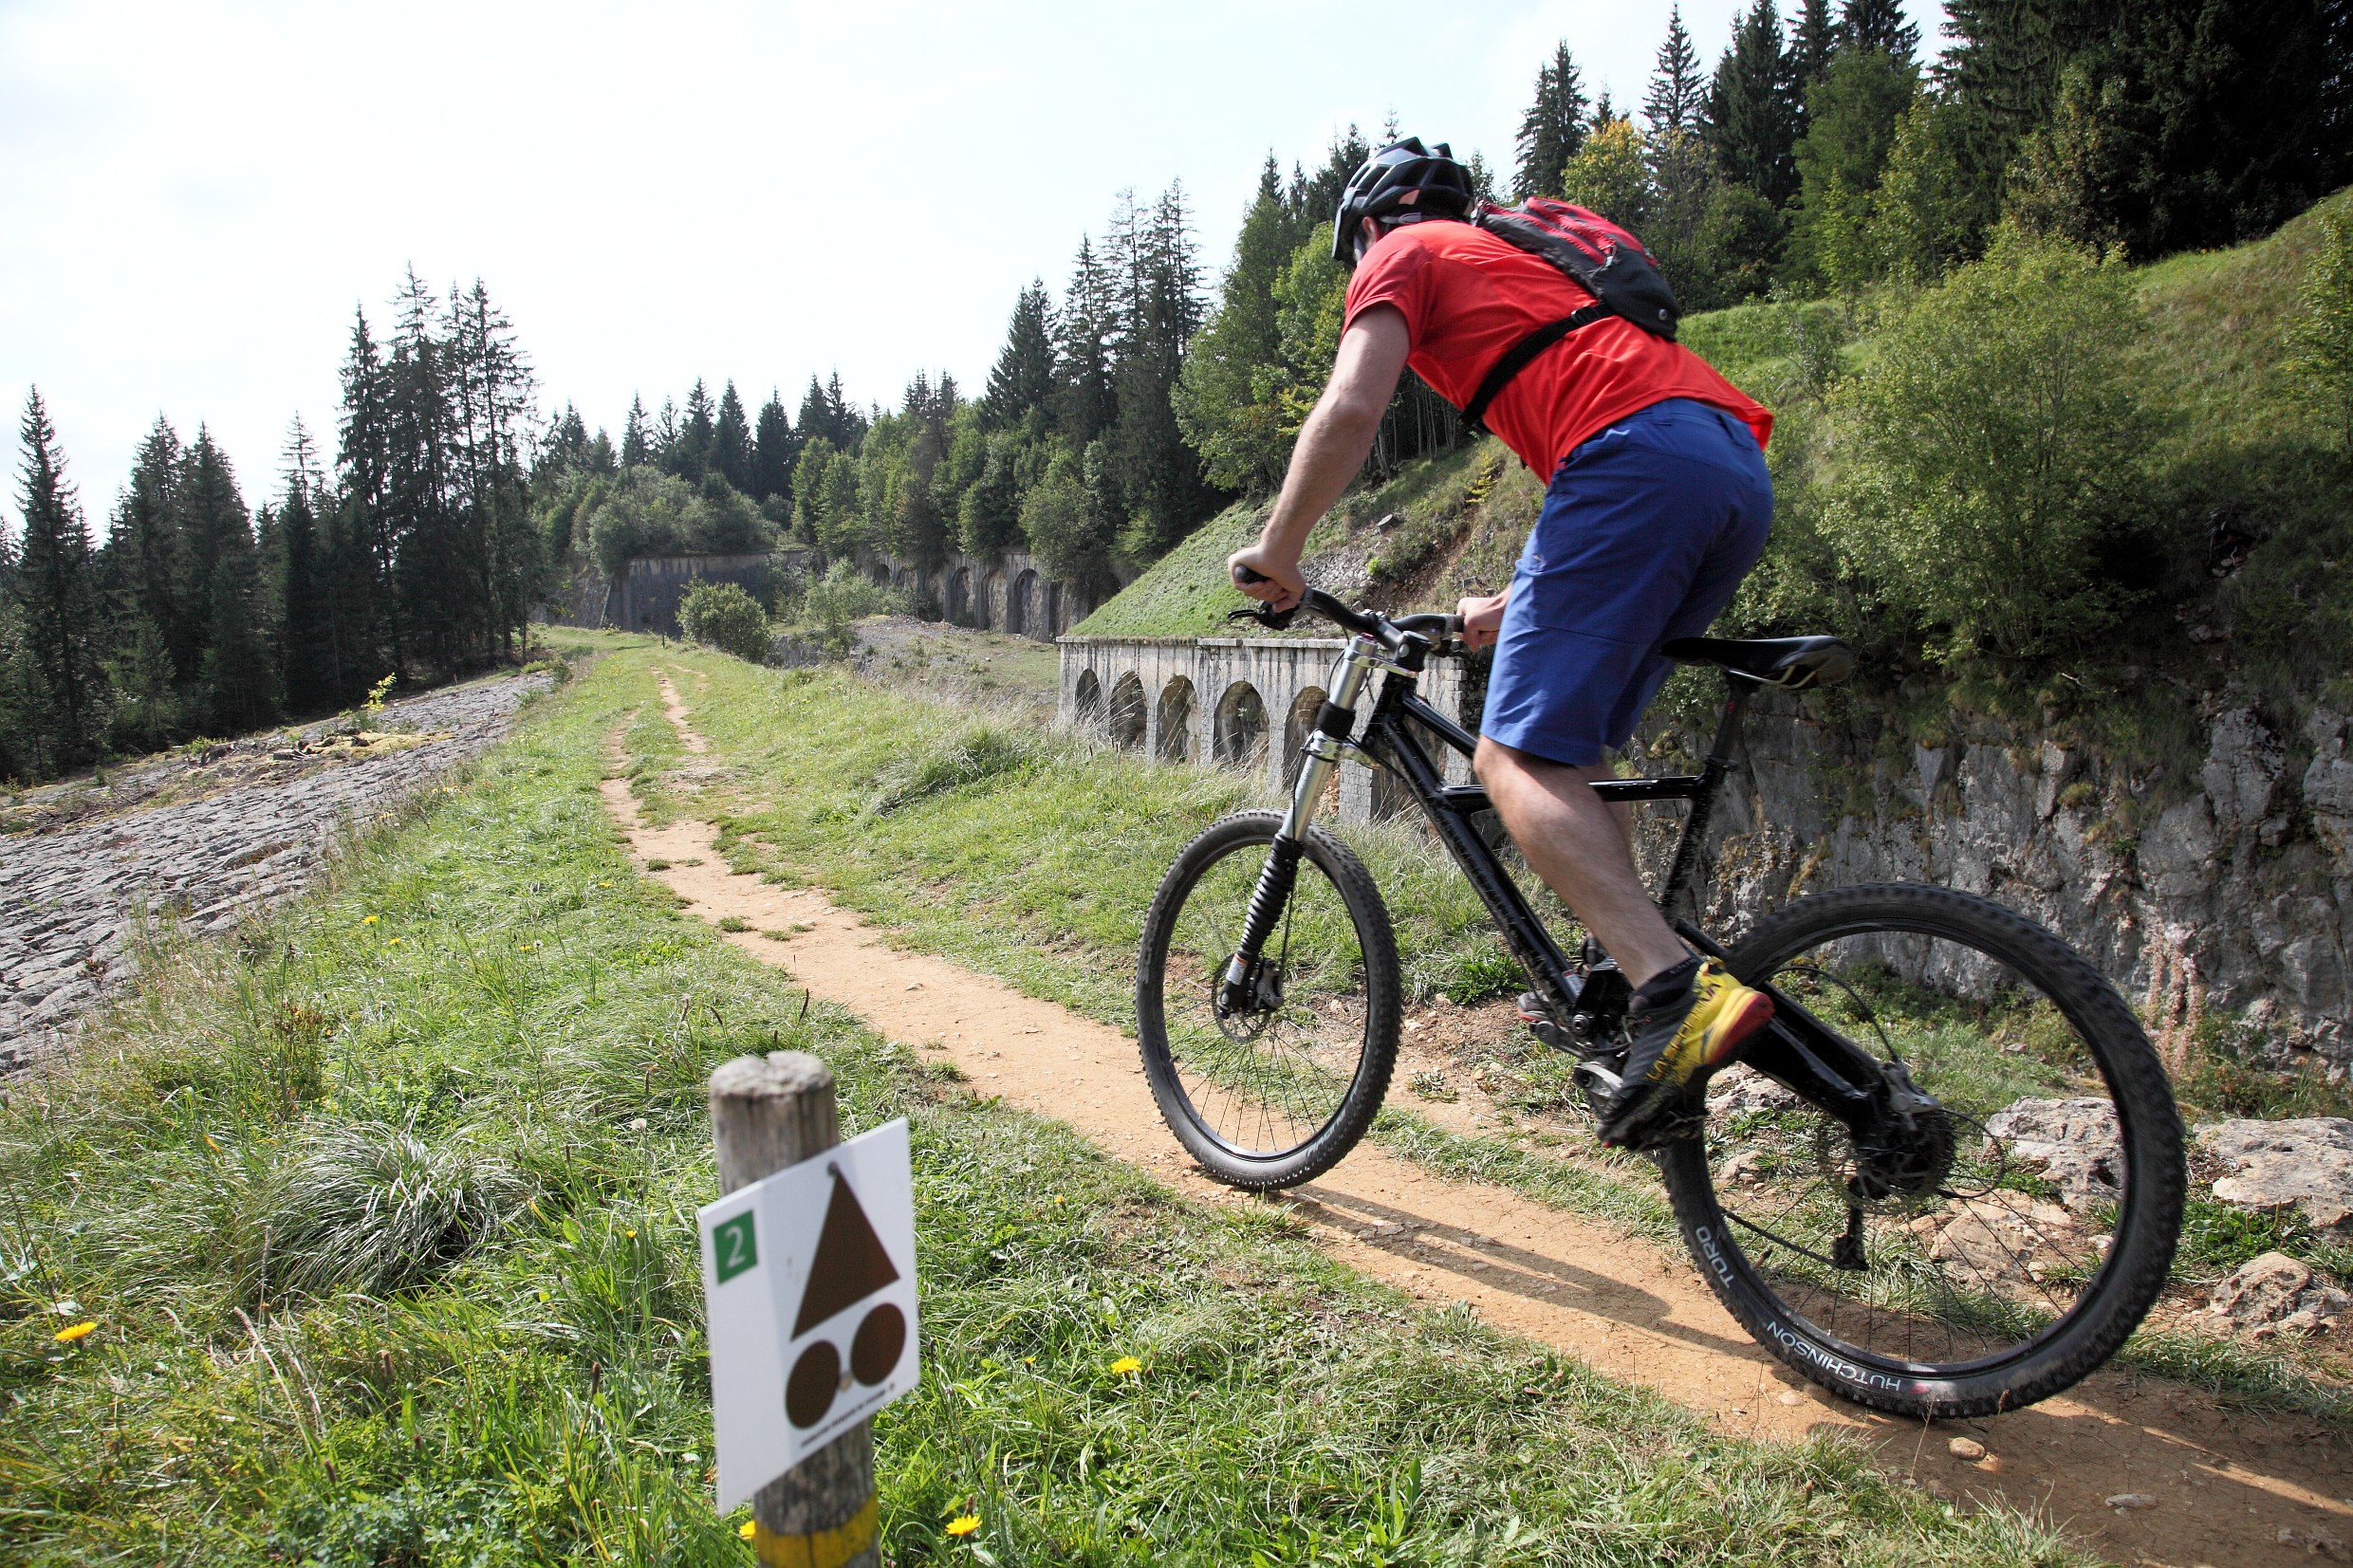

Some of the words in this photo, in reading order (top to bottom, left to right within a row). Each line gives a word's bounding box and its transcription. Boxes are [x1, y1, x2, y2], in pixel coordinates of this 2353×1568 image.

[725, 1226, 747, 1268] 2
[1695, 1226, 1734, 1289] TORO
[1767, 1321, 1900, 1392] HUTCHINSON
